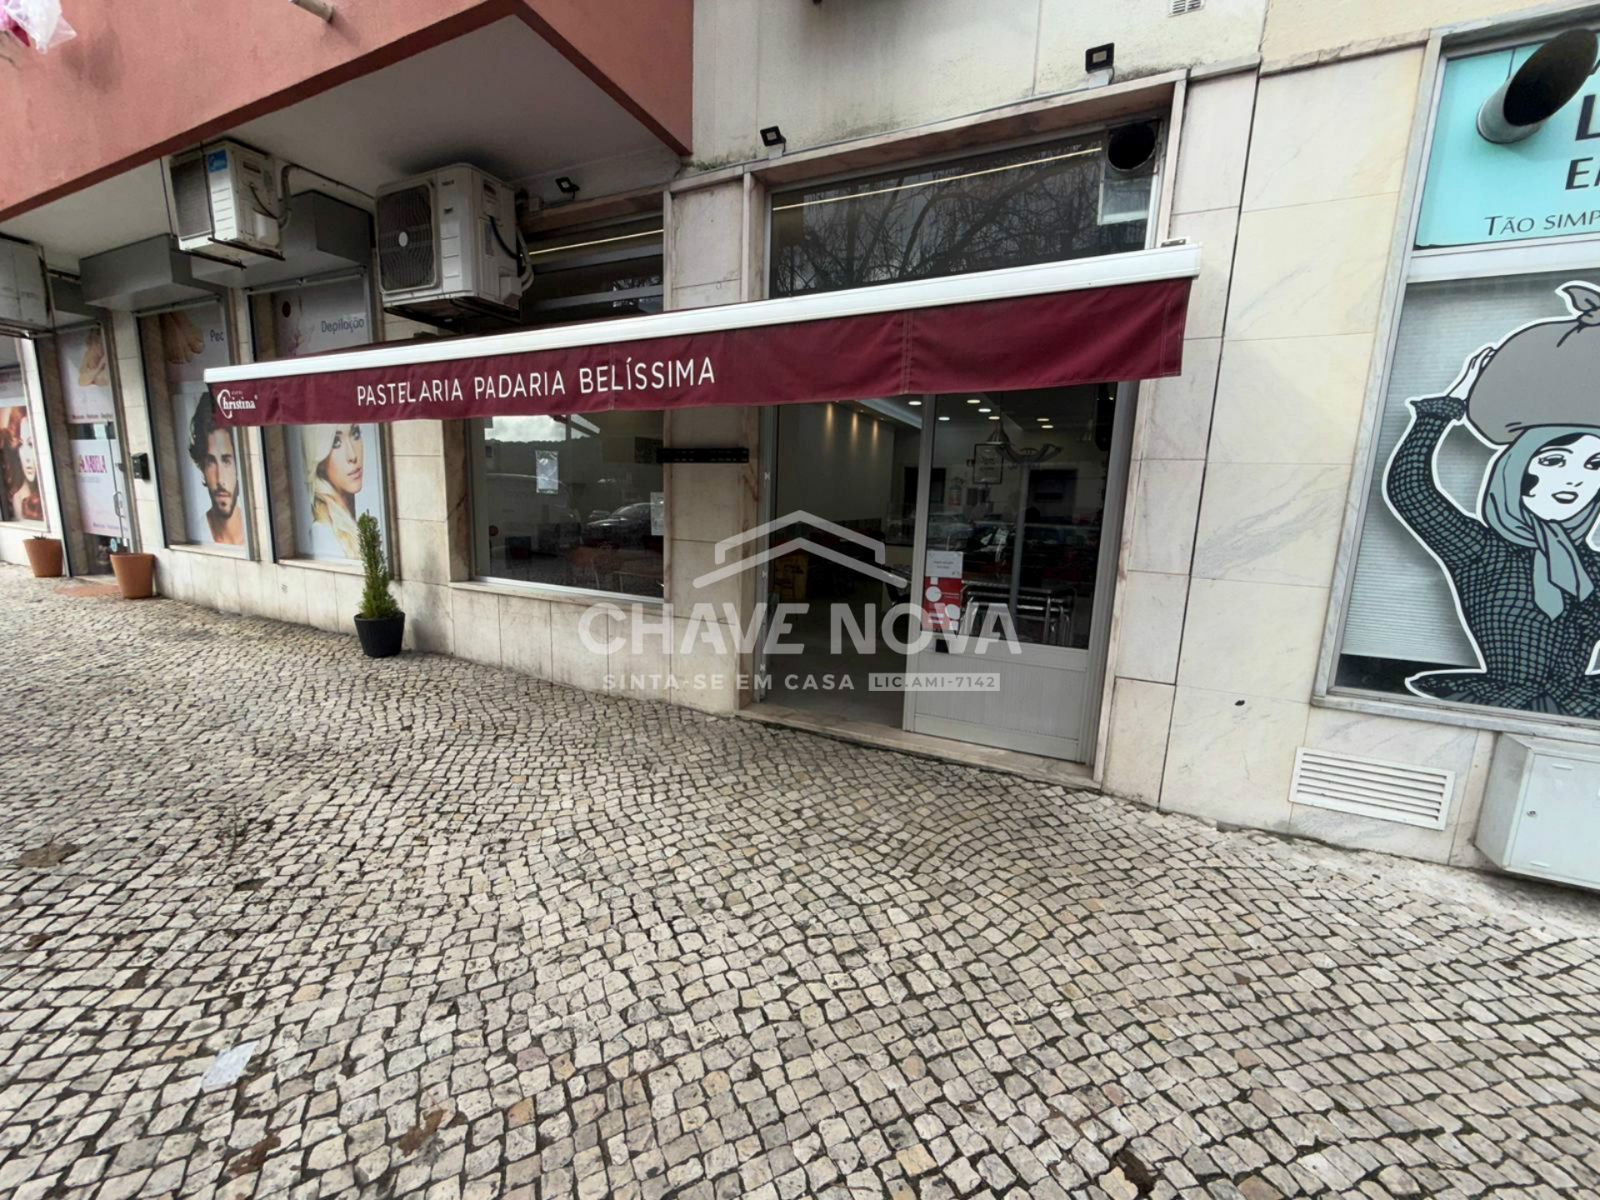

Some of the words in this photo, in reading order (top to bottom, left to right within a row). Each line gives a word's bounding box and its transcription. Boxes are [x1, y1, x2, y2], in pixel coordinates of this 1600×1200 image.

[1565, 157, 1600, 190] E
[1484, 215, 1535, 236] TÃO
[321, 317, 365, 335] Depilação
[356, 378, 464, 407] PASTELARIA
[474, 370, 566, 400] PADARIA
[579, 356, 716, 394] BELÍSSIMA
[216, 388, 257, 420] Christina
